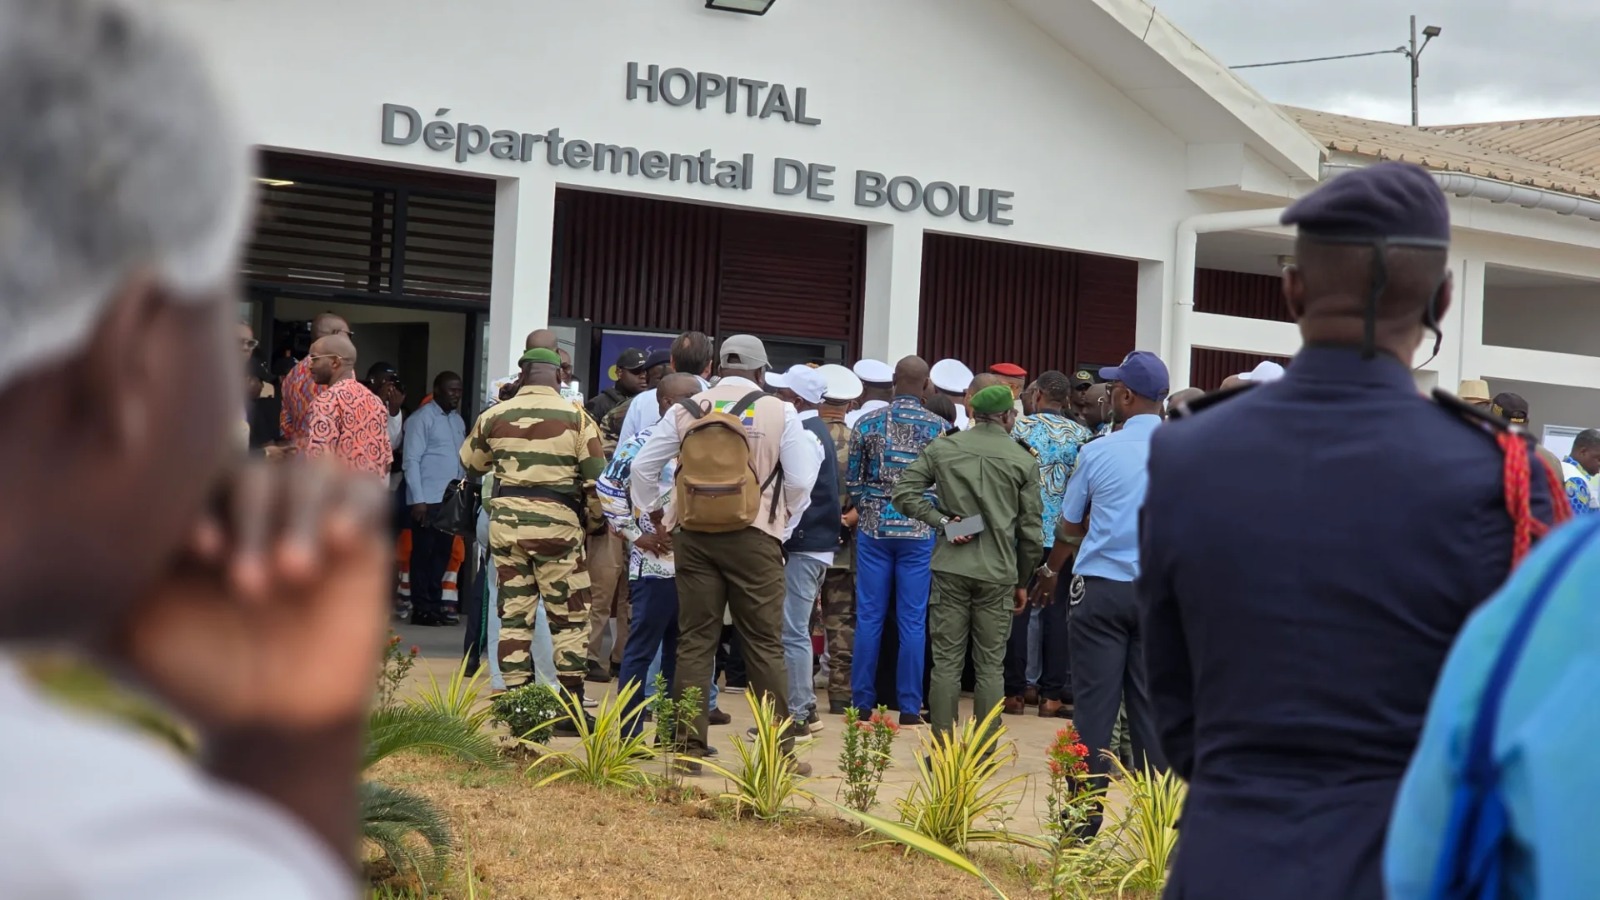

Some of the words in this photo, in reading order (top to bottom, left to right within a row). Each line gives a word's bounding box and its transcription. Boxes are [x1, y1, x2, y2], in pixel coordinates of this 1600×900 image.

[626, 62, 821, 126] HOPITAL
[381, 103, 753, 191] Départemental
[773, 158, 835, 202] DE
[854, 170, 1014, 226] BOOUE
